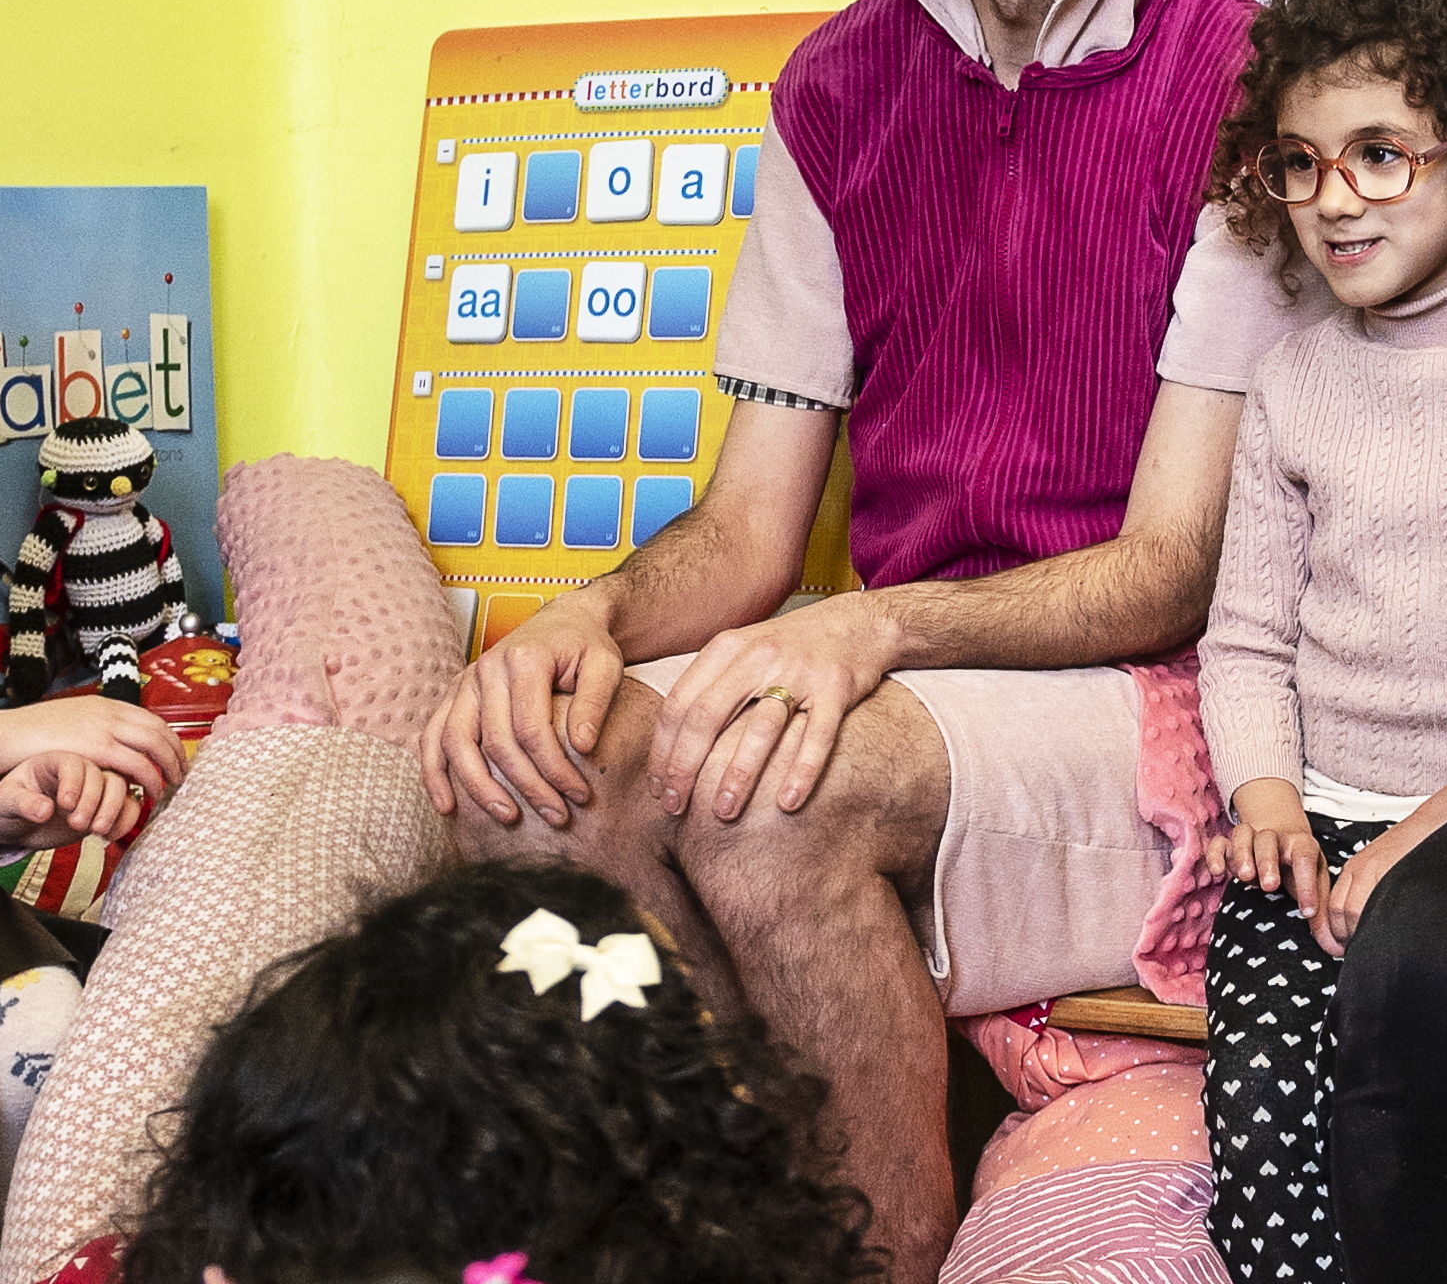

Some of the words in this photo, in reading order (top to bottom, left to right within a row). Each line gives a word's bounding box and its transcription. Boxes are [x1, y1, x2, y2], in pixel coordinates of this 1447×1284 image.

[585, 74, 715, 103] letterbord
[481, 167, 493, 207] i
[608, 166, 632, 196] o
[680, 168, 705, 200] a
[457, 287, 502, 319] aa
[586, 286, 637, 318] oo
